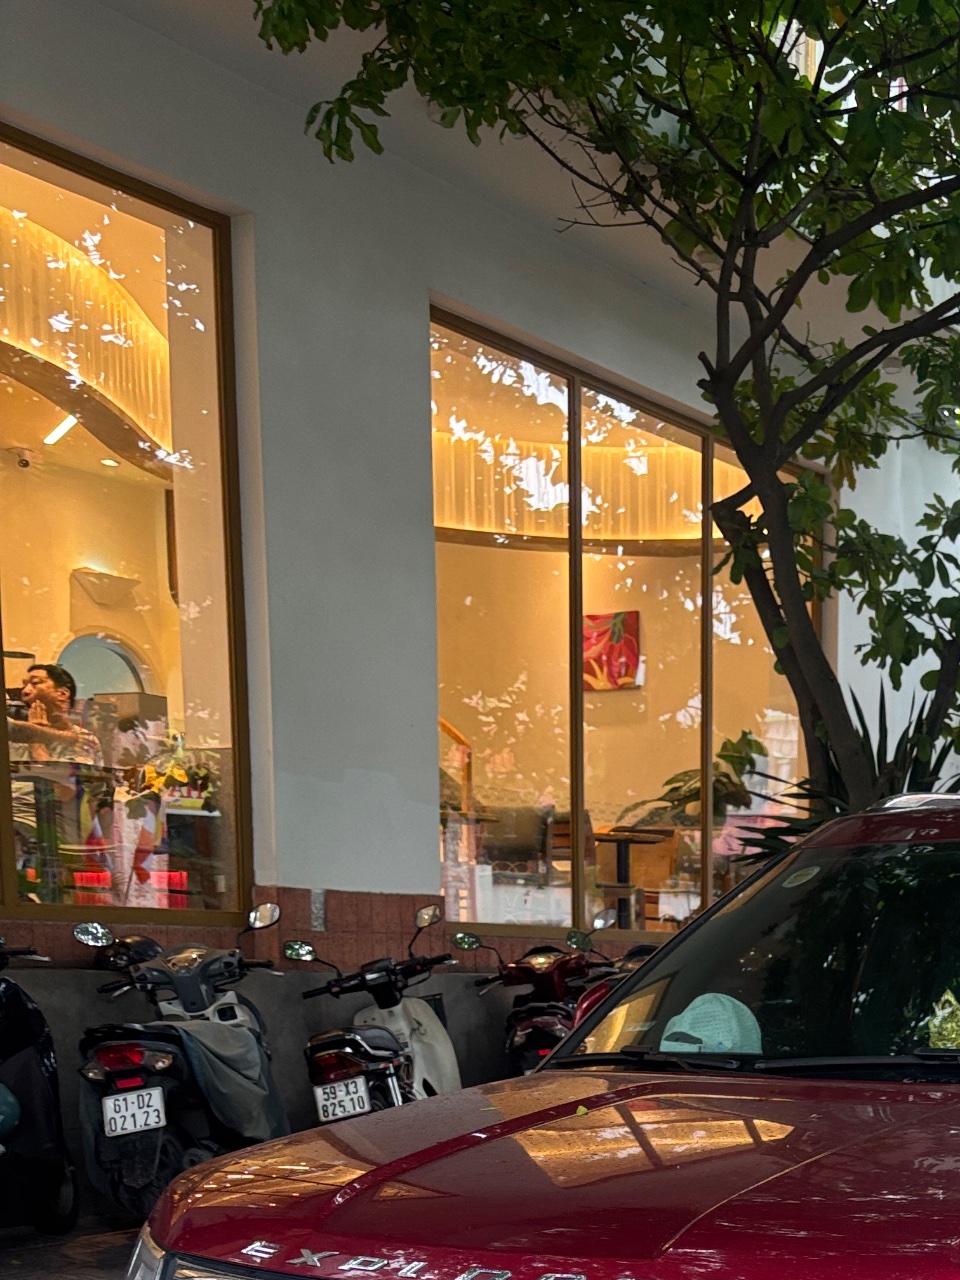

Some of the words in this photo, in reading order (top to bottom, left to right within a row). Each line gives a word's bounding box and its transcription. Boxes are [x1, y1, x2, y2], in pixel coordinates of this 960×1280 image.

[321, 1080, 359, 1102] 59-X3
[113, 1092, 154, 1114] 61-D2
[321, 1095, 366, 1119] 825.10
[108, 1108, 162, 1133] 021.23
